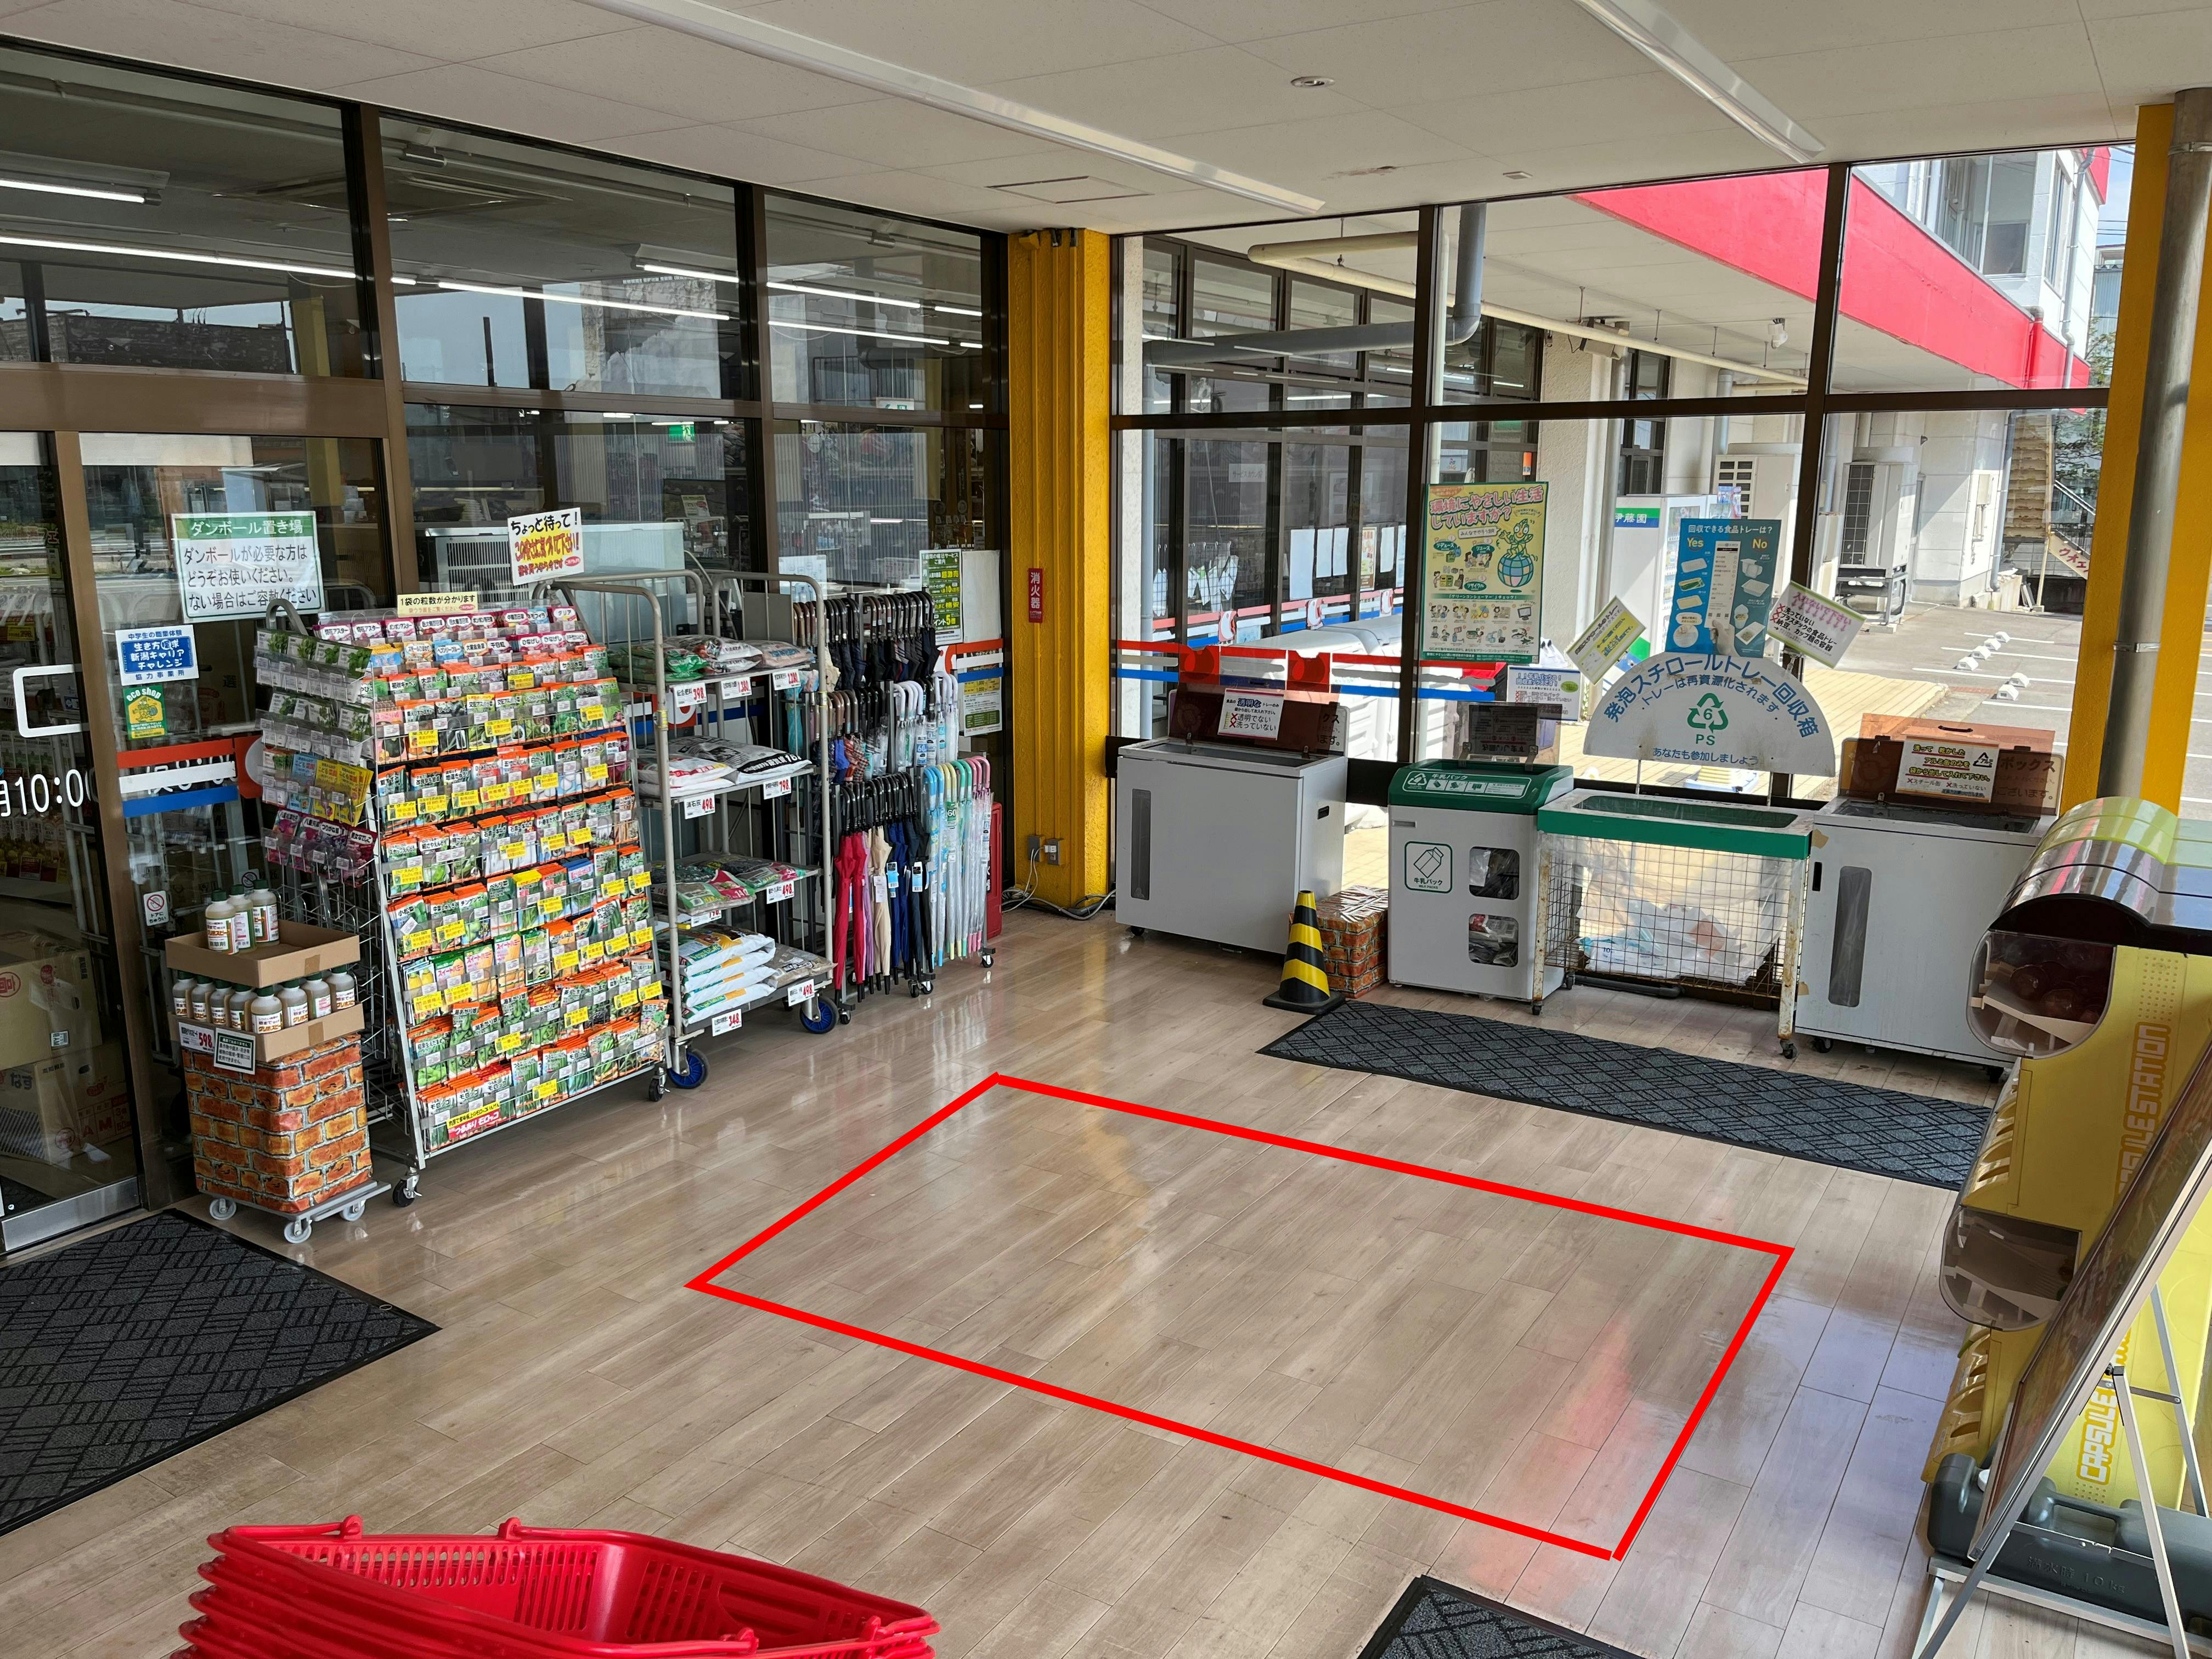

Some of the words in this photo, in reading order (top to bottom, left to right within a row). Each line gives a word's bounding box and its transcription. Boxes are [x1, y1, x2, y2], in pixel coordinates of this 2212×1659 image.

[1430, 485, 1544, 514] 環境にやさしい生活
[1431, 506, 1513, 530] していますか?
[190, 520, 303, 536] ダンボール置き場
[1688, 524, 1773, 534] 回収できる食品トレーは?
[1687, 538, 1704, 548] Yes
[1752, 539, 1768, 549] No
[184, 544, 308, 565] ダンボールが必要な方は
[2059, 548, 2089, 572] ウオエ
[188, 568, 294, 588] どうぞお使いください。
[1031, 572, 1040, 608] 消火器
[400, 595, 475, 606] 1袋の粒数が分かります
[1783, 607, 1814, 626] 洗っていない
[128, 629, 182, 639] 中学生の職業体験
[1780, 613, 1837, 645] プラスチックの食品トレー
[131, 649, 184, 662] 新潟キャリア
[138, 658, 183, 670] チャレンジ
[126, 689, 141, 702] eco
[142, 687, 162, 699] shop
[693, 687, 704, 700] 398
[1604, 654, 1819, 738] 発泡スチロールトレー回収箱
[1642, 674, 1780, 713] トレーは再資源化されます
[1237, 698, 1262, 708] 透明な
[1237, 714, 1271, 723] 透明でない
[1703, 708, 1713, 720] 6
[1236, 721, 1276, 731] 洗っていない
[1695, 734, 1715, 746] PS
[1653, 748, 1758, 765] あなたも参加しましょう
[1938, 747, 1965, 755] 乾かした
[1925, 757, 1970, 767] アルミ缶のみを
[1909, 767, 1990, 781] 袋から出して入れて下さい。
[702, 798, 712, 811] 498
[1414, 877, 1442, 885] 牛乳パック
[782, 883, 792, 896] 498
[398, 905, 414, 917] 小松菜
[803, 984, 813, 996] 498
[729, 1013, 740, 1026] 348
[199, 1032, 213, 1048] 598
[2129, 1024, 2168, 1115] STATION
[2080, 1391, 2118, 1483] CAPSULE
[2084, 1573, 2104, 1587] 10
[2109, 1580, 2125, 1593] kg
